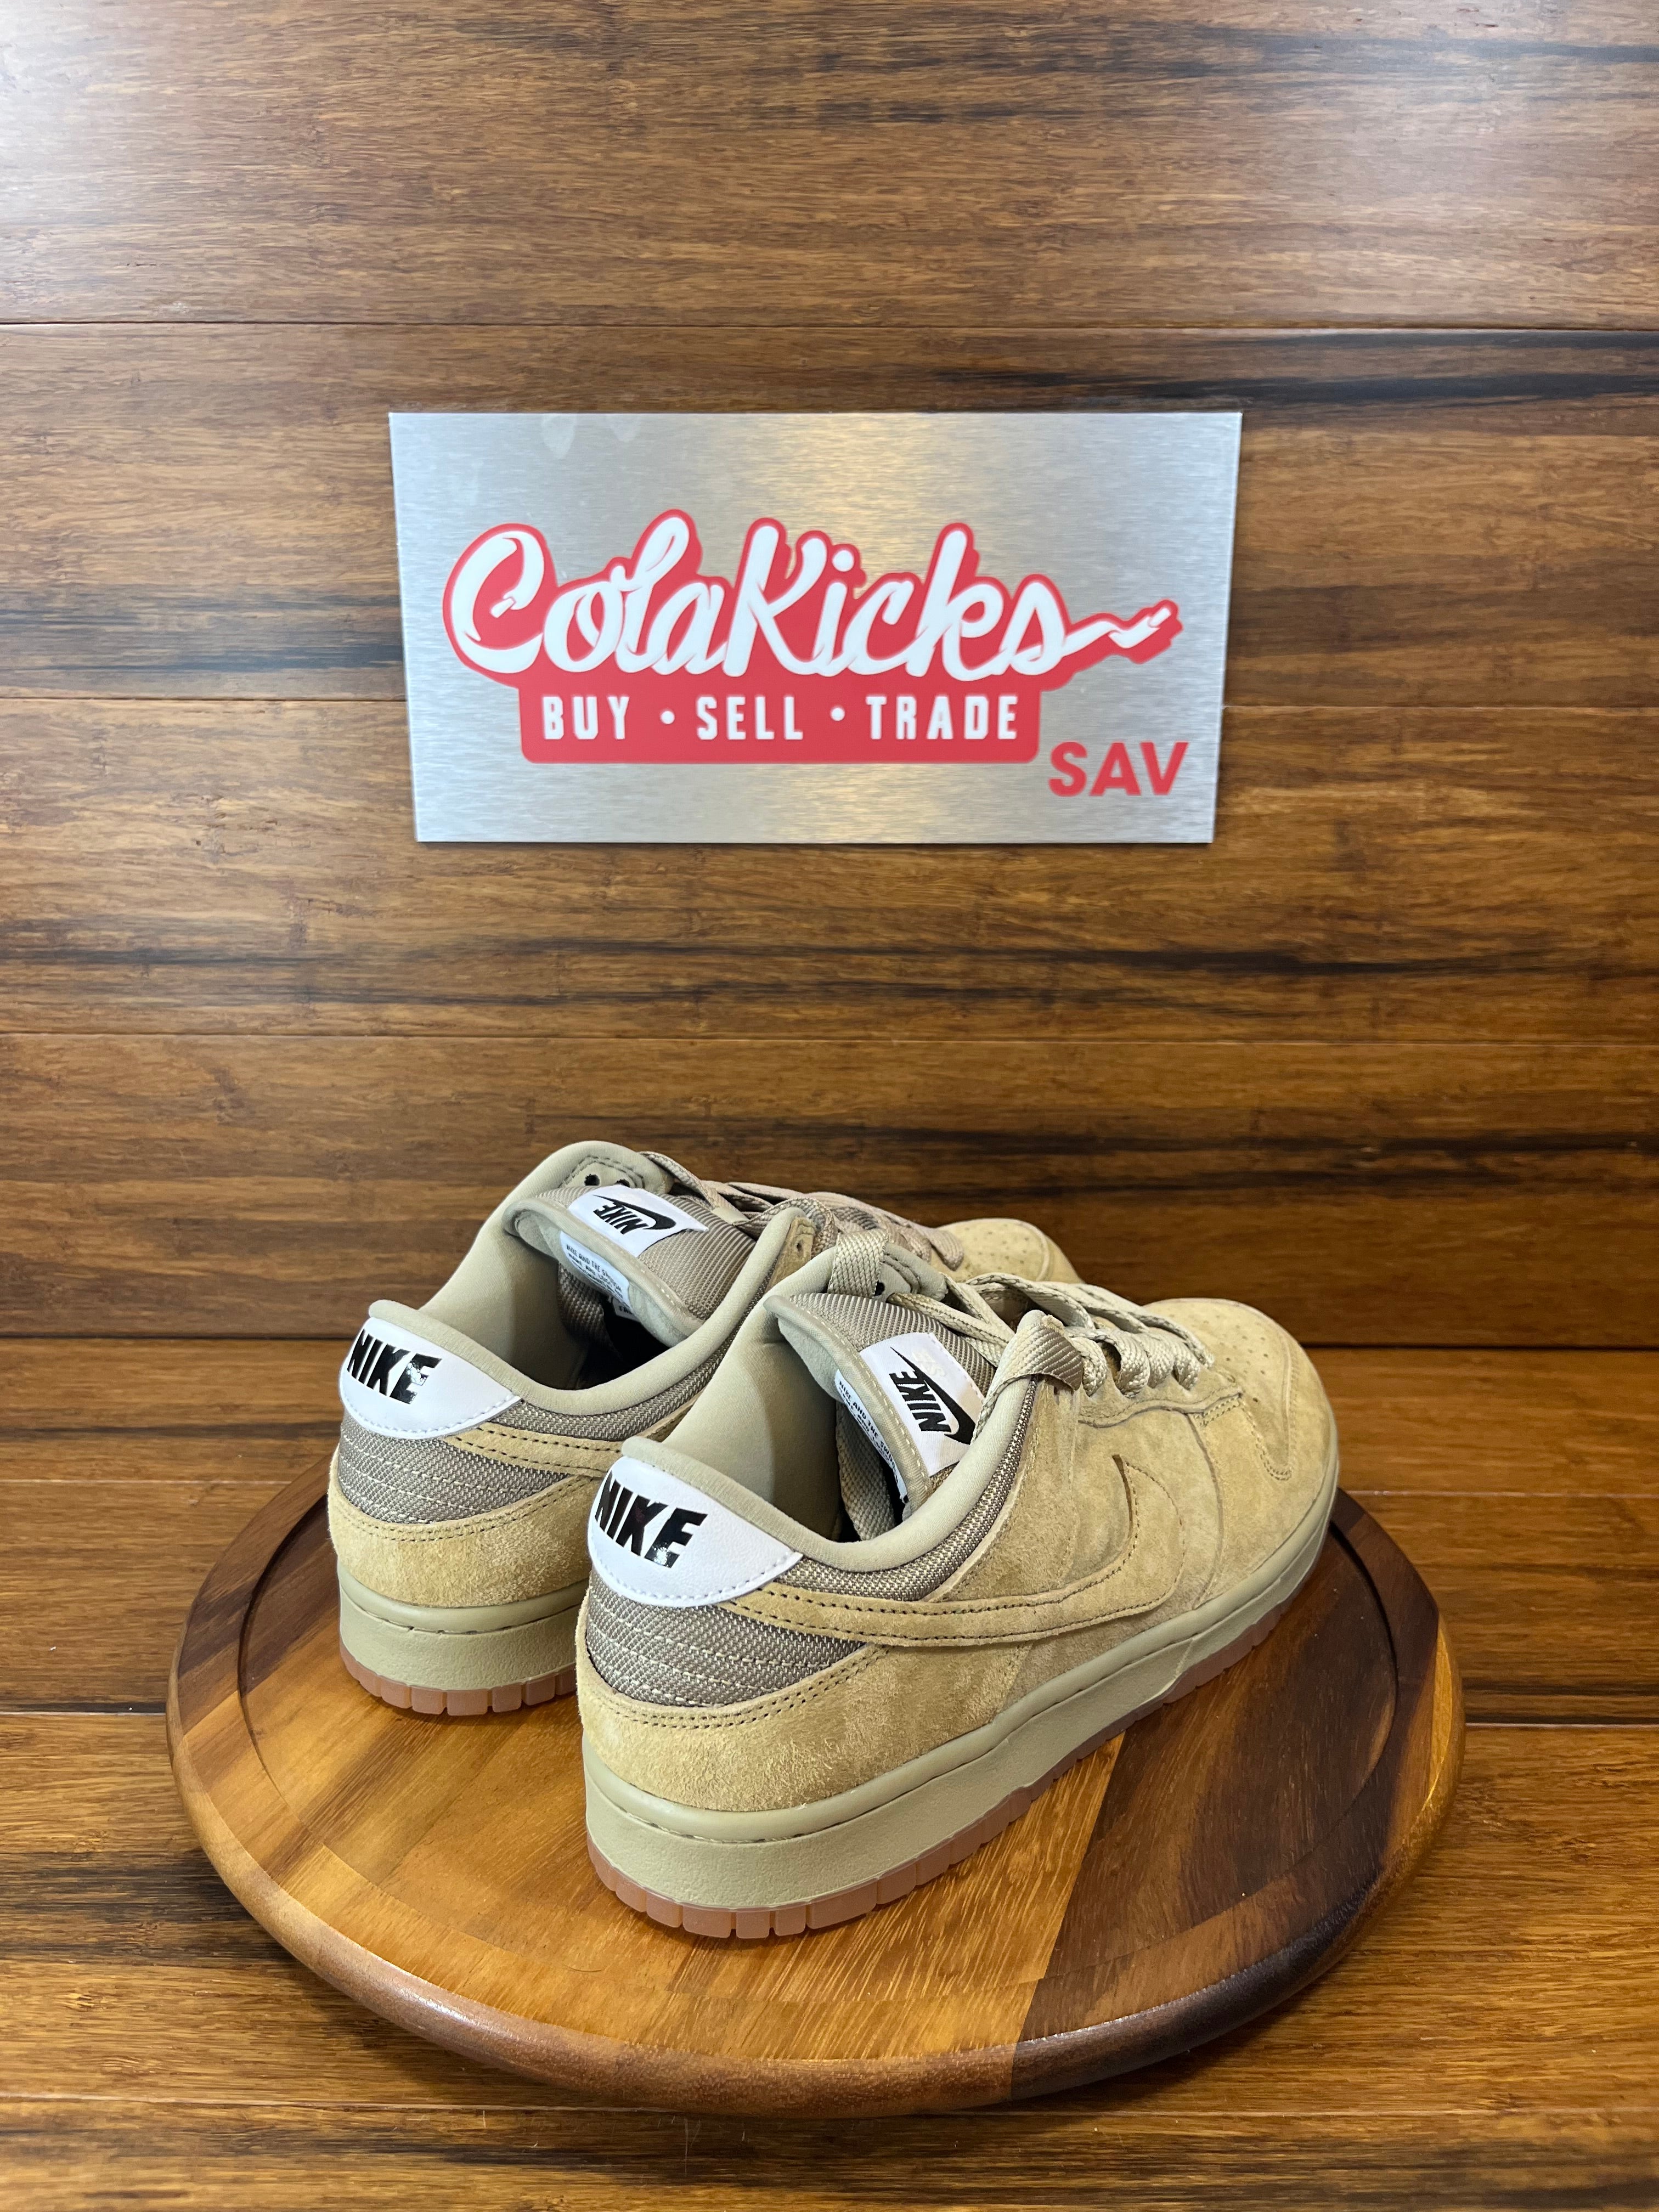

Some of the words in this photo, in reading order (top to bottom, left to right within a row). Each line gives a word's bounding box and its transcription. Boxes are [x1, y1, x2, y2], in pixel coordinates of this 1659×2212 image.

[449, 515, 1173, 681] ColaKicks
[542, 695, 630, 740] BUY
[696, 695, 804, 741] SELL
[865, 695, 1019, 741] TRADE
[1048, 741, 1189, 797] SAV
[593, 1201, 648, 1235] NIKE
[347, 1328, 443, 1404] NIKE
[839, 1380, 852, 1402] NIKE
[853, 1402, 867, 1420] AND
[868, 1420, 879, 1438] THE
[889, 1370, 952, 1432] NIKE
[595, 1470, 708, 1568] NIKE
